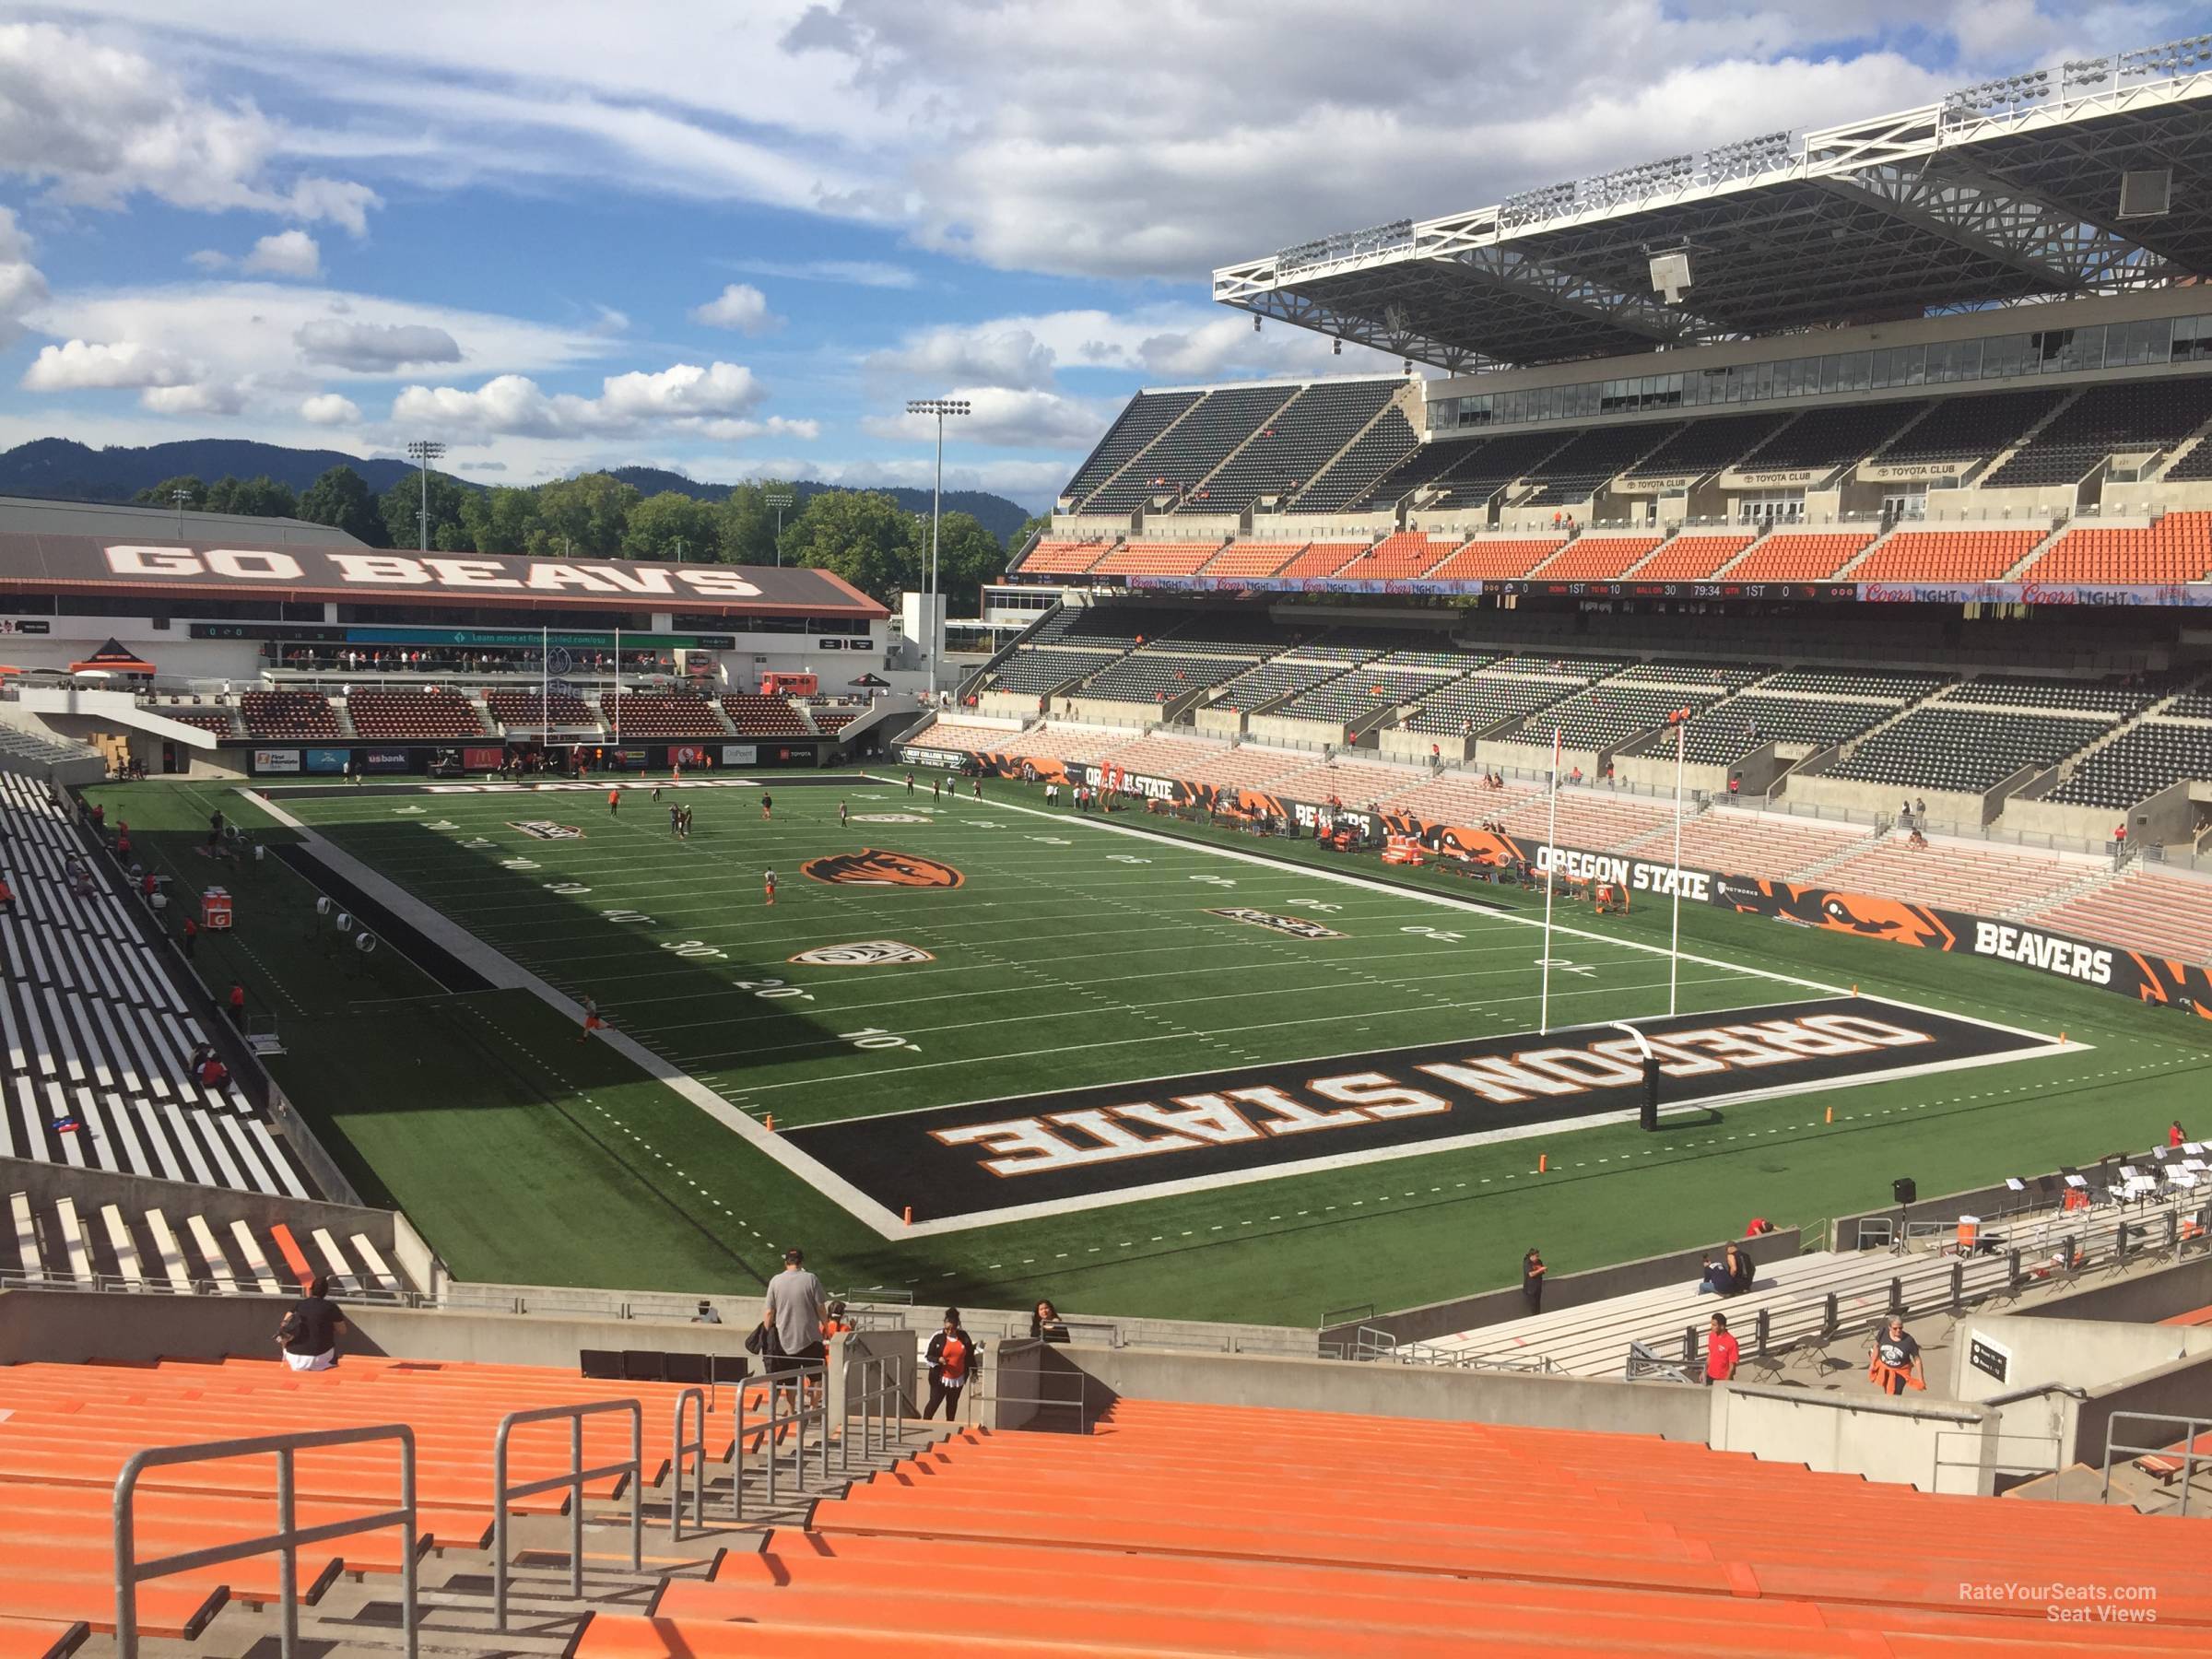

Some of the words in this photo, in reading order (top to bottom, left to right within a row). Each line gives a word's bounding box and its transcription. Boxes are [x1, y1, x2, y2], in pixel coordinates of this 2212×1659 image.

[1756, 474, 1787, 483] TOYOTA
[1789, 472, 1811, 481] CLUB
[1892, 467, 1927, 477] TOYOTA
[1930, 465, 1956, 474] CLUB
[1637, 481, 1665, 489] TOYOTA
[1666, 478, 1686, 488] CLUB
[104, 545, 305, 580] GO
[325, 553, 763, 596] BEAVS
[1131, 575, 1159, 589] Coors
[1159, 581, 1182, 589] LIGHT
[1217, 577, 1245, 591] Coors
[1246, 582, 1269, 591] LIGHT
[1302, 579, 1327, 593] Coors
[1327, 583, 1347, 593] LIGHT
[1385, 580, 1412, 594] Coors
[1412, 584, 1436, 594] LIGHT
[1569, 583, 1585, 594] 1ST
[1610, 584, 1620, 594] 10
[1665, 584, 1677, 595] 30
[1694, 585, 1721, 596] 79:34
[1746, 585, 1765, 596] 1ST
[1865, 583, 1913, 604] Coors
[1913, 590, 1958, 604] LIGHT
[2021, 584, 2077, 605] Coors
[2078, 591, 2128, 605] LIGHT
[472, 633, 495, 641] Learn
[369, 754, 406, 763] usbank
[920, 751, 943, 759] COLLEGE
[421, 781, 764, 793] BEAVERS
[1135, 775, 1173, 800] STATE
[1536, 846, 1630, 885] OREGON
[1633, 863, 1710, 900] STATE
[215, 914, 225, 925] G
[660, 940, 721, 959] 30
[1974, 922, 2112, 985] BEAVERS
[732, 978, 805, 1000] 20
[837, 1028, 906, 1050] 10
[925, 1071, 1452, 1178] STATE
[1412, 1012, 1936, 1104] OREGON
